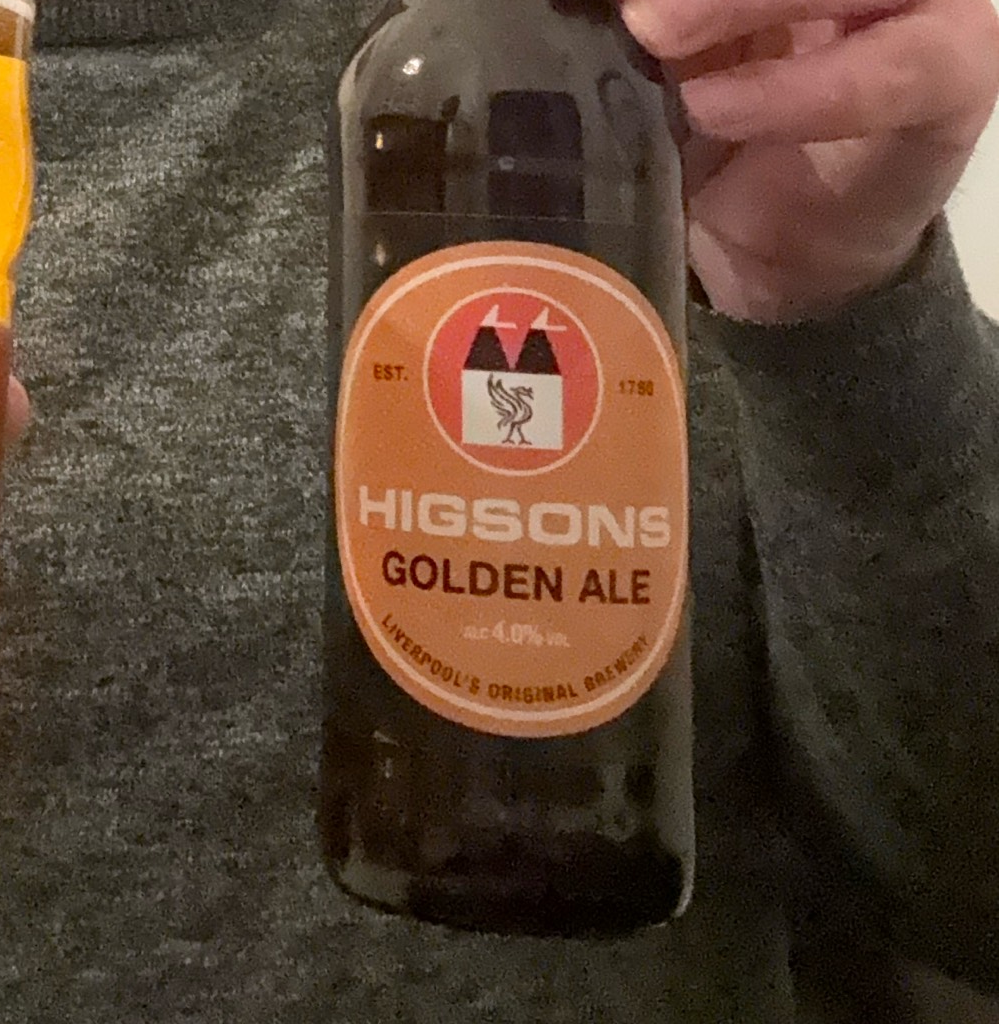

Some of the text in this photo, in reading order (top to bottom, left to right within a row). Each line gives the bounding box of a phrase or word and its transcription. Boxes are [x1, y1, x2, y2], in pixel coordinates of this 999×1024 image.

[373, 364, 408, 382] EST.
[359, 485, 671, 549] HIGSONS
[382, 550, 651, 605] GOLDEN ALE
[381, 613, 650, 704] LIVERPOOL'S ORIGINAL BREWERY
[492, 619, 544, 647] 4.0%
